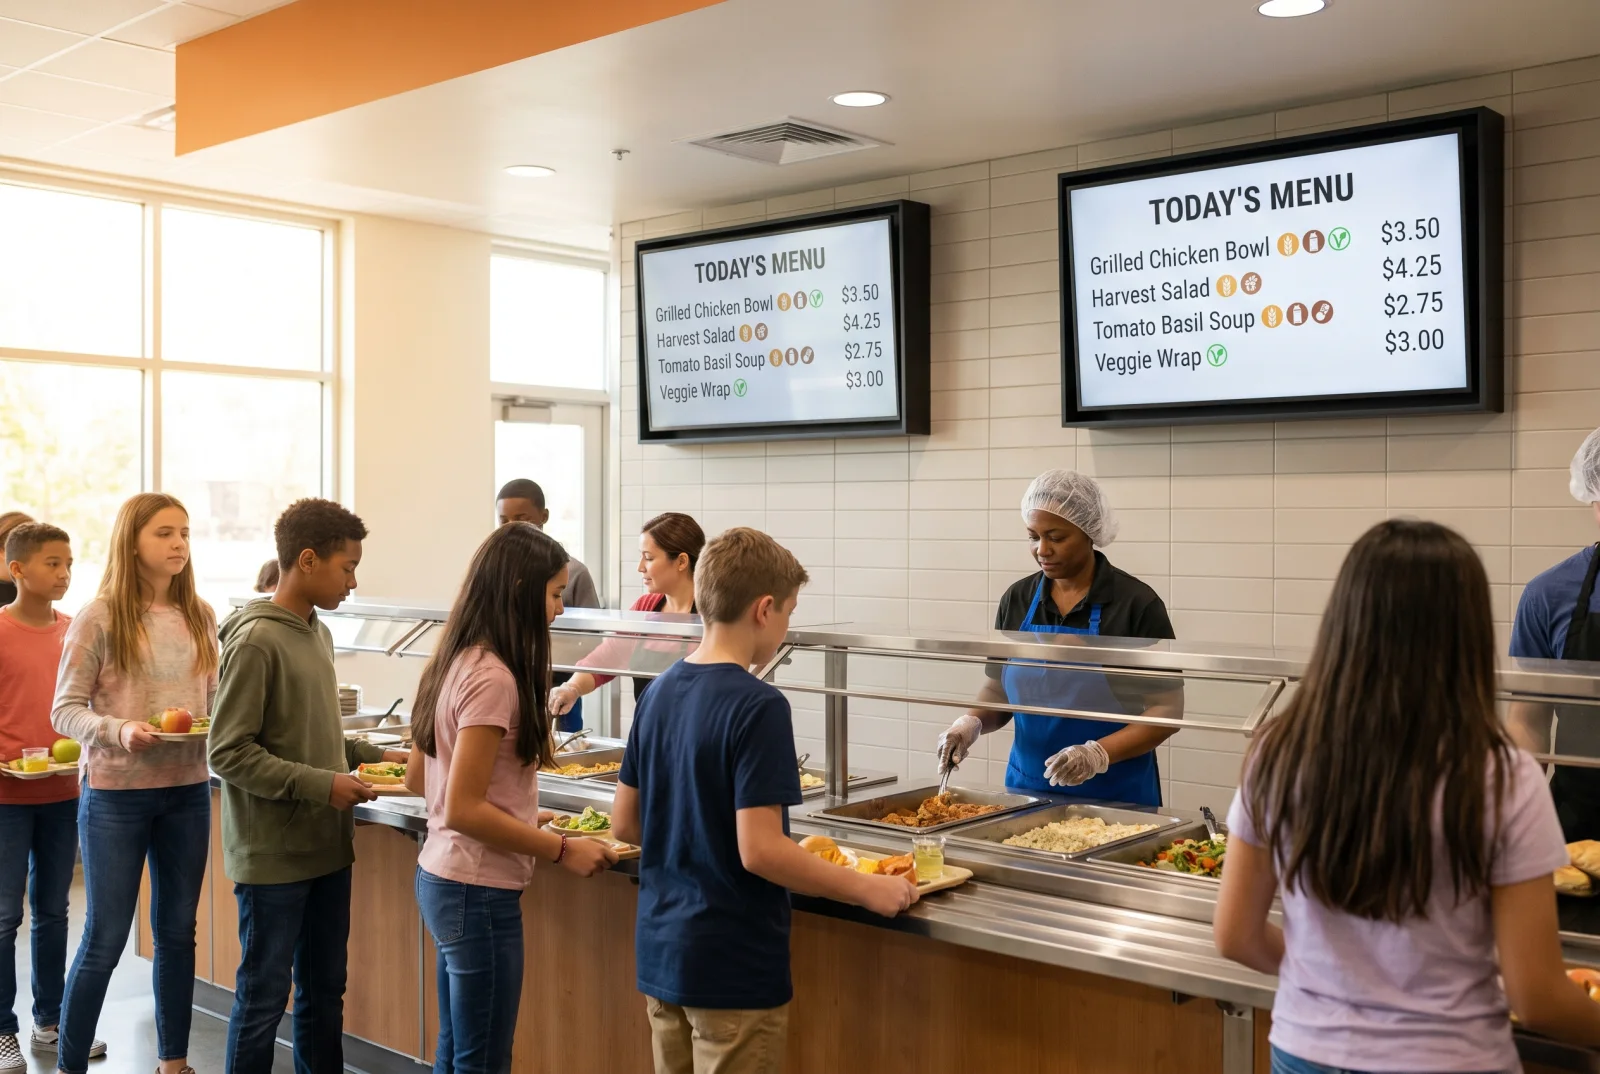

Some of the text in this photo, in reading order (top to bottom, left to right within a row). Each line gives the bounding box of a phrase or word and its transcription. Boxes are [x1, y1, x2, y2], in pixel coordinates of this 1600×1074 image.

[1149, 173, 1353, 225] TODAY'S MENU
[695, 247, 825, 283] TODAY'S MENU
[1091, 217, 1439, 275] Grilled Chicken Bowl $3.50
[1093, 254, 1441, 307] Harvest Salad $4.25
[656, 284, 878, 322] Grilled Chicken Bowl $3.50
[1093, 291, 1443, 339] Tomato Basil Soup $2.75
[657, 312, 880, 348] Harvest Salad $4.25
[658, 341, 882, 373] Tomato Basil Soup $2.75
[1095, 329, 1443, 375] Veggie Wrap $3.00
[660, 370, 883, 403] Veggie Wrap $3.00
